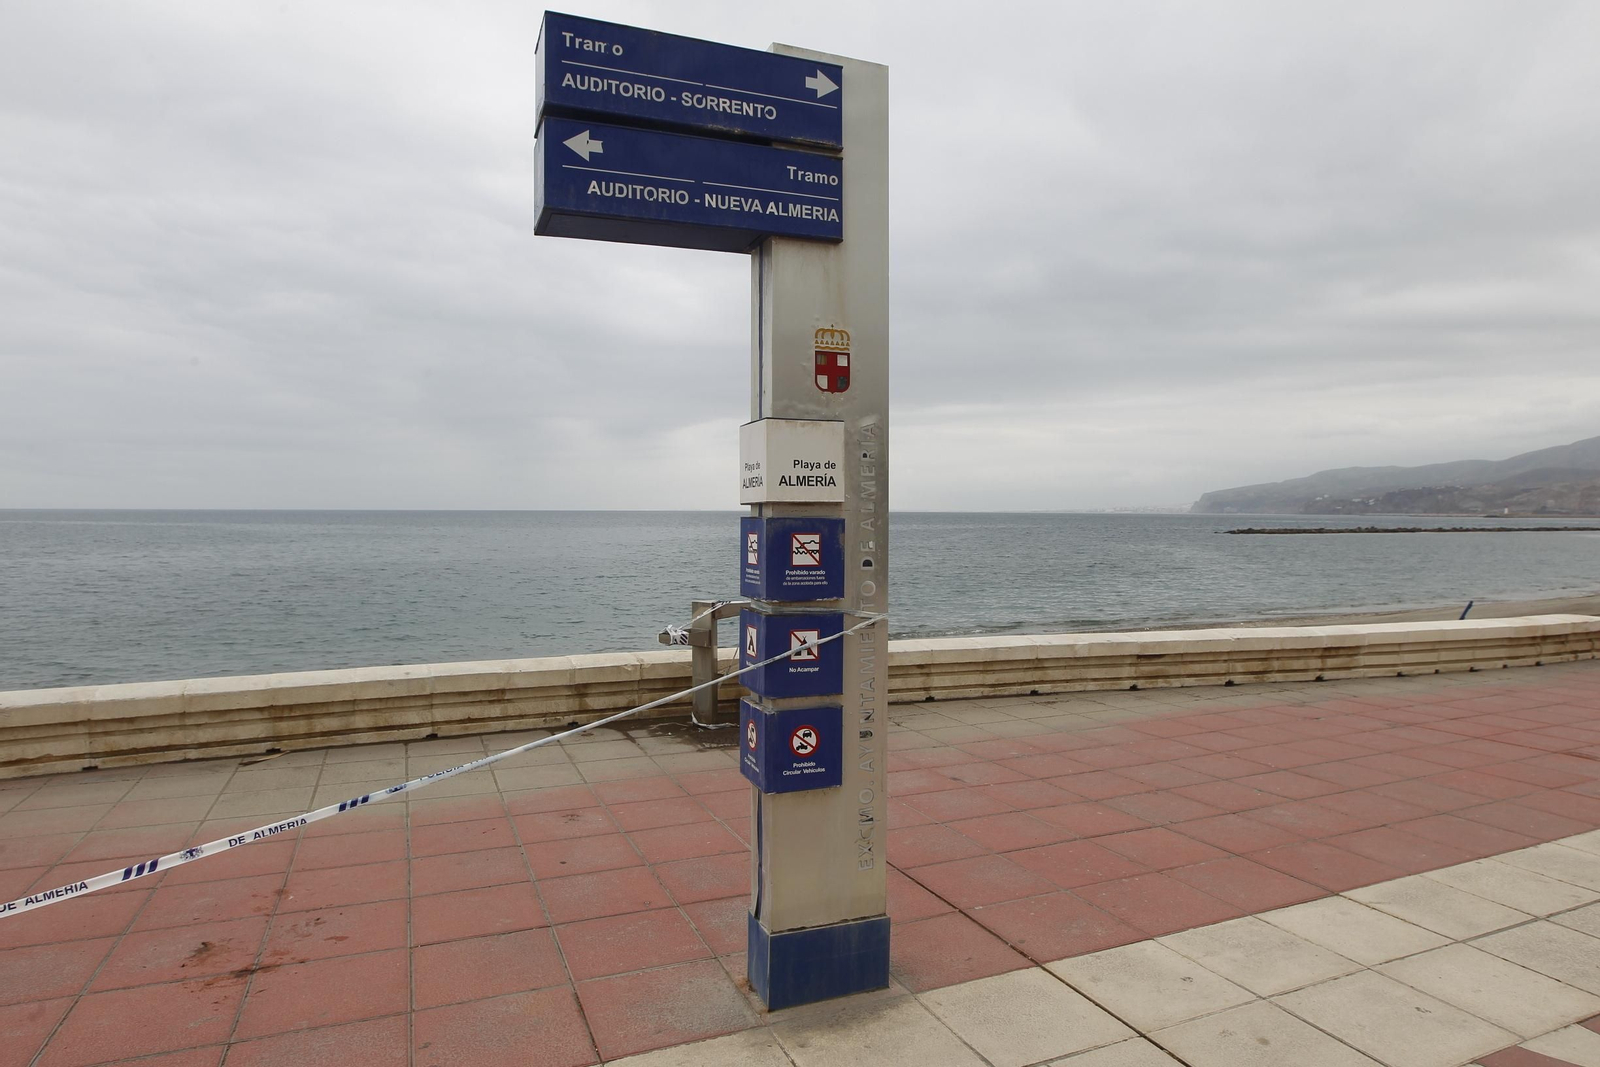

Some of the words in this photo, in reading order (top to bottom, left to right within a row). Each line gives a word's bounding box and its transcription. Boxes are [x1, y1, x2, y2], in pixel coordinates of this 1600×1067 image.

[561, 72, 666, 102] AUDITORIO
[681, 92, 777, 120] SORRENTO
[786, 165, 839, 186] Tramo
[587, 180, 689, 205] AUDITORIO
[704, 193, 763, 214] NUEVA
[765, 201, 840, 223] ALMERIA
[745, 462, 755, 473] Playa
[755, 460, 761, 470] de
[793, 459, 821, 471] Playa
[824, 460, 836, 470] de
[778, 473, 837, 487] ALMERÍA
[860, 540, 876, 571] DE
[228, 835, 246, 848] DE
[253, 818, 307, 841] ALMERIA
[24, 881, 89, 906] ALMERIA
